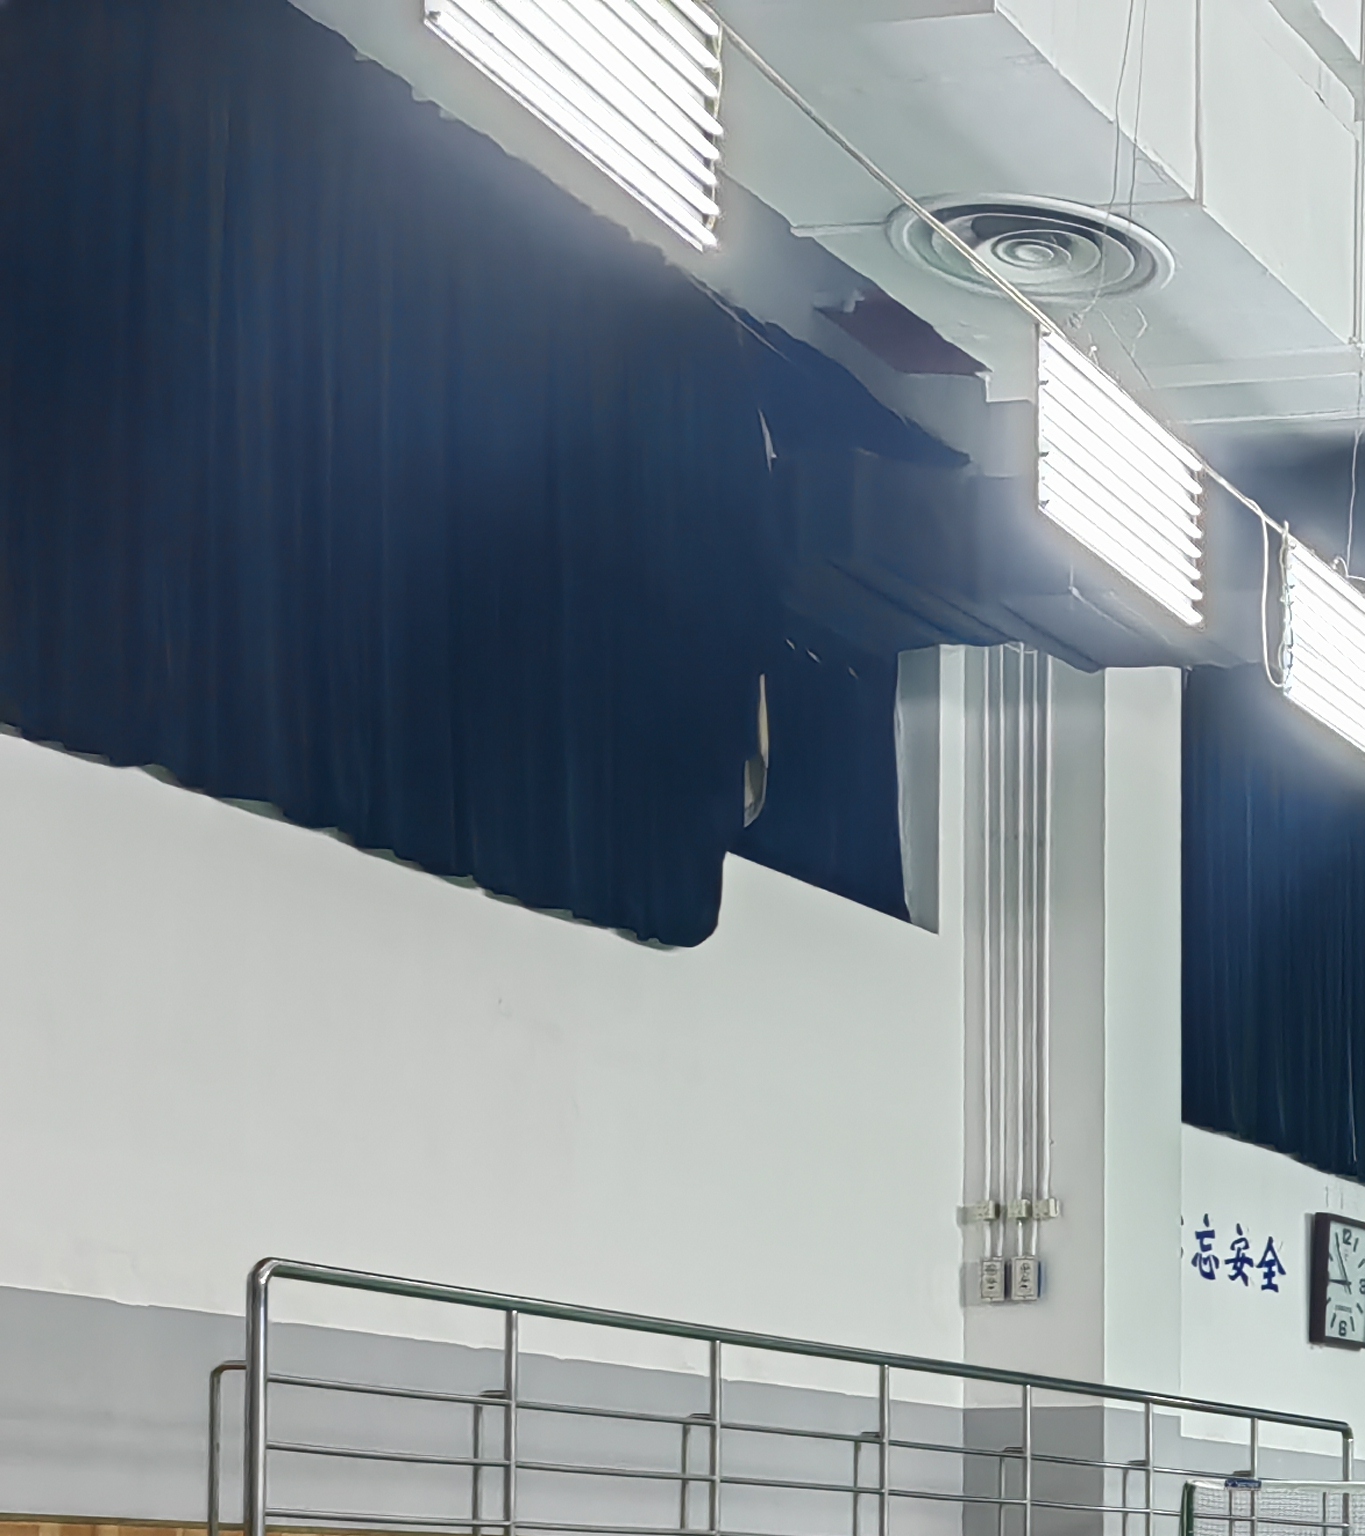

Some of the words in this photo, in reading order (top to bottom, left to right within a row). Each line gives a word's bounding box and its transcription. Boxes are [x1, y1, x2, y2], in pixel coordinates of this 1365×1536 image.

[1342, 1227, 1352, 1246] 12
[1181, 1214, 1286, 1293] 忘安全
[1338, 1320, 1347, 1337] 6
